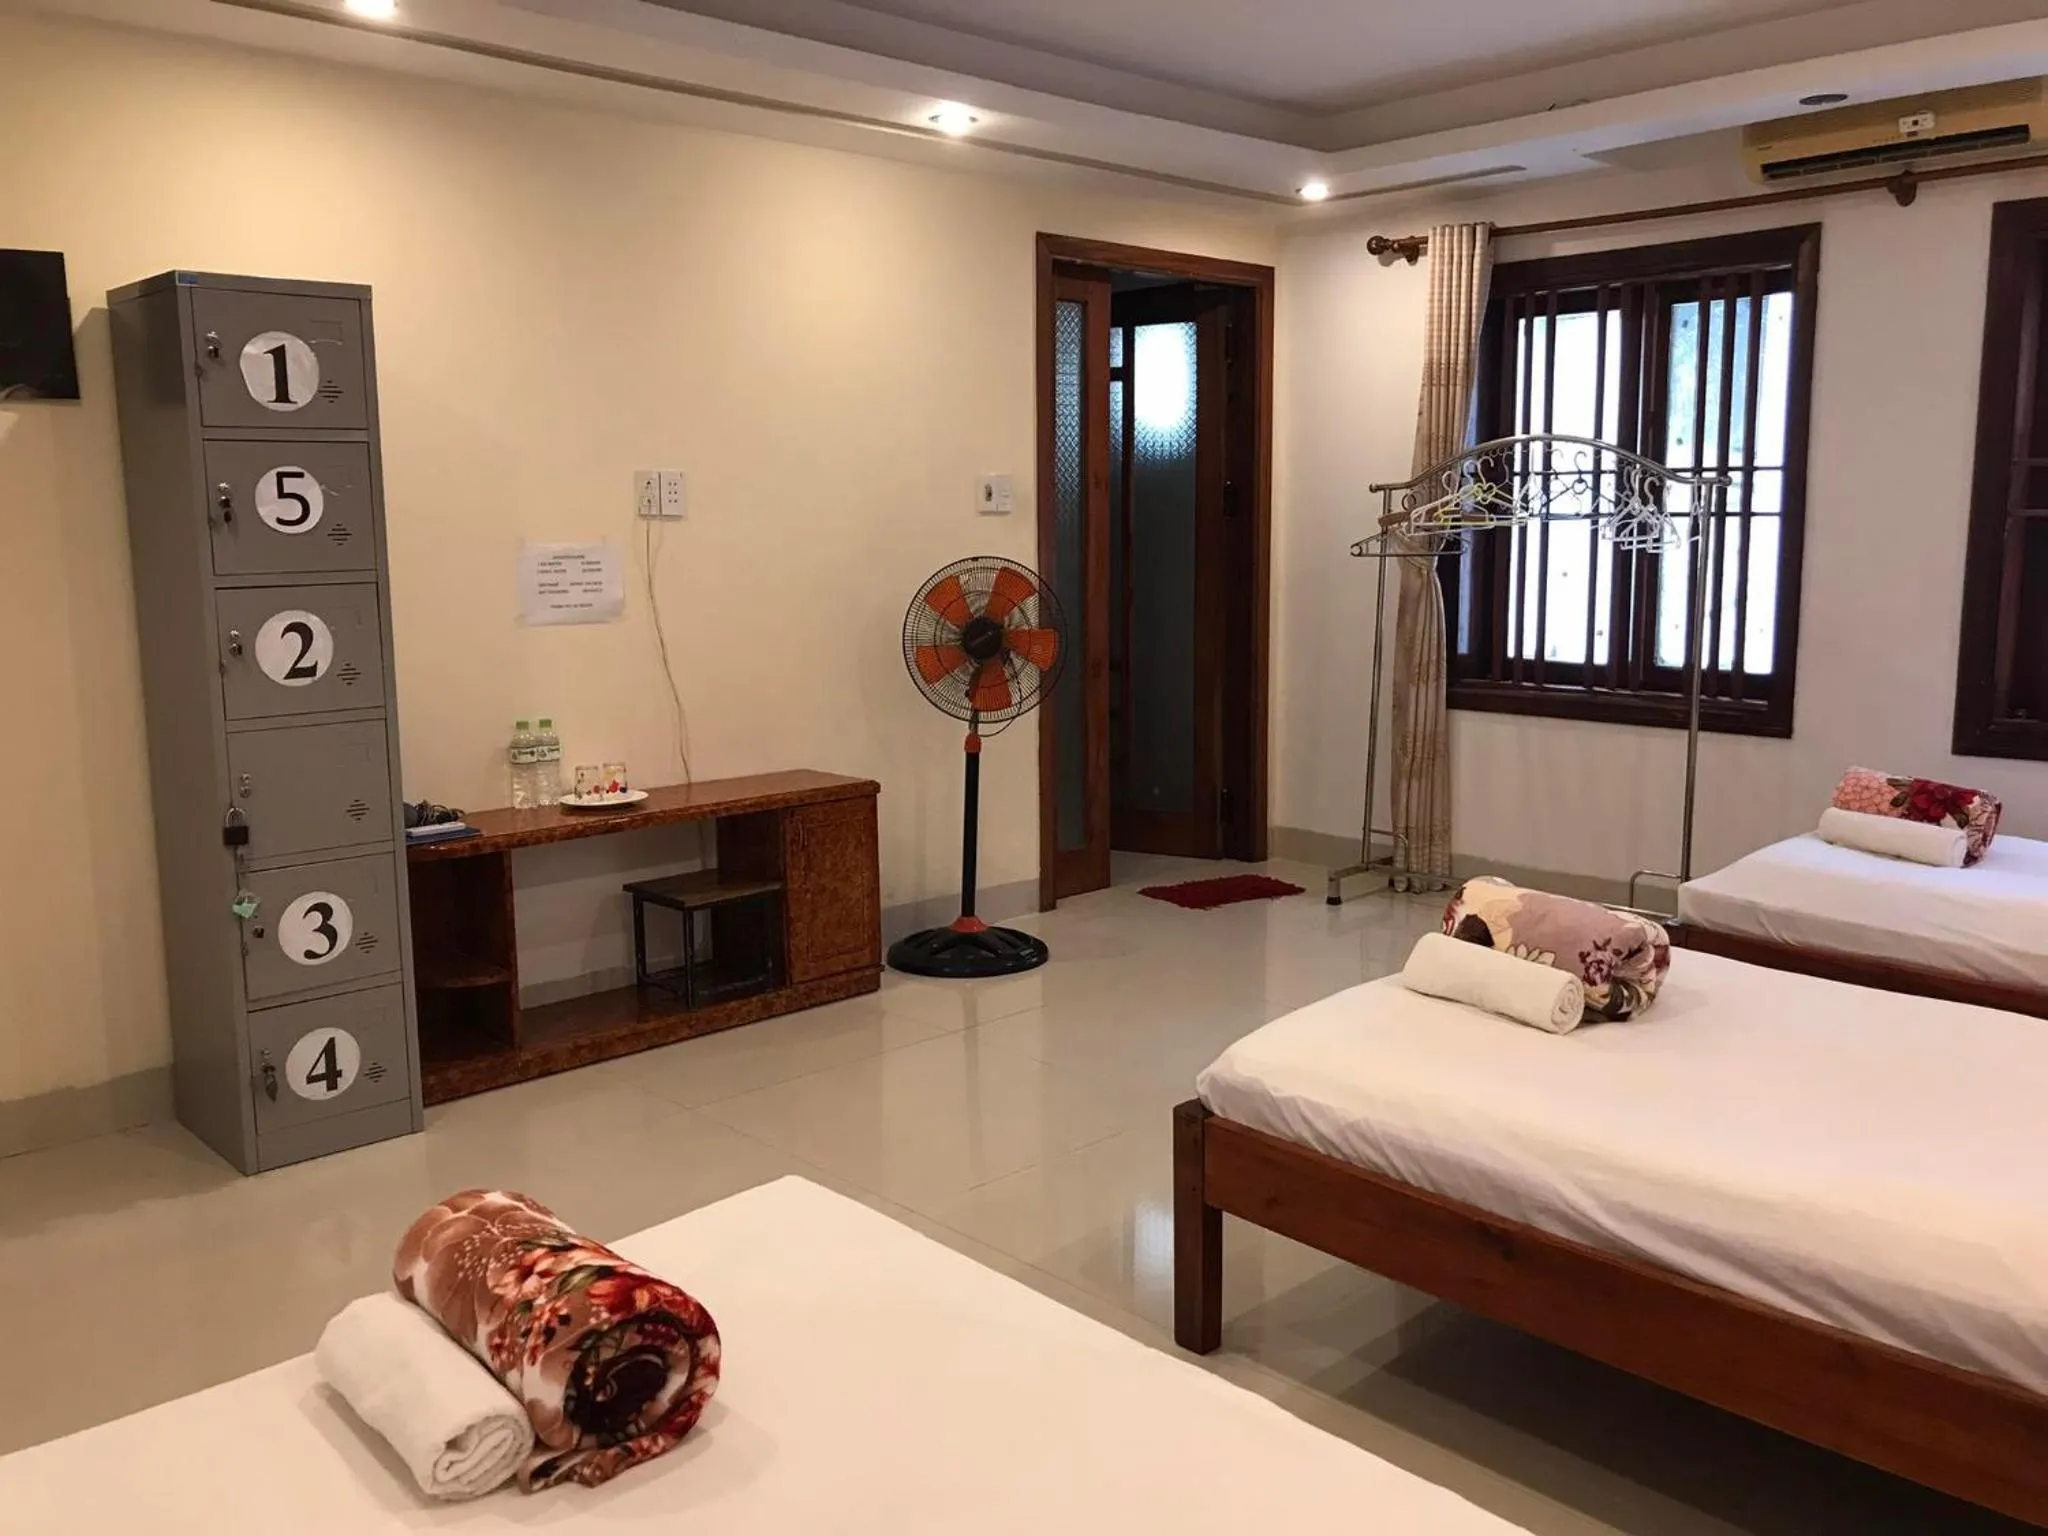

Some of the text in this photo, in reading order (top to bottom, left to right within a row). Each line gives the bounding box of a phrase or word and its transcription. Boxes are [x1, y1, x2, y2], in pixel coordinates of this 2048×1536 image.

[264, 344, 297, 404] 1
[276, 471, 310, 526] 5
[281, 622, 318, 680] 2
[303, 902, 338, 960] 3
[306, 1037, 342, 1092] 4
